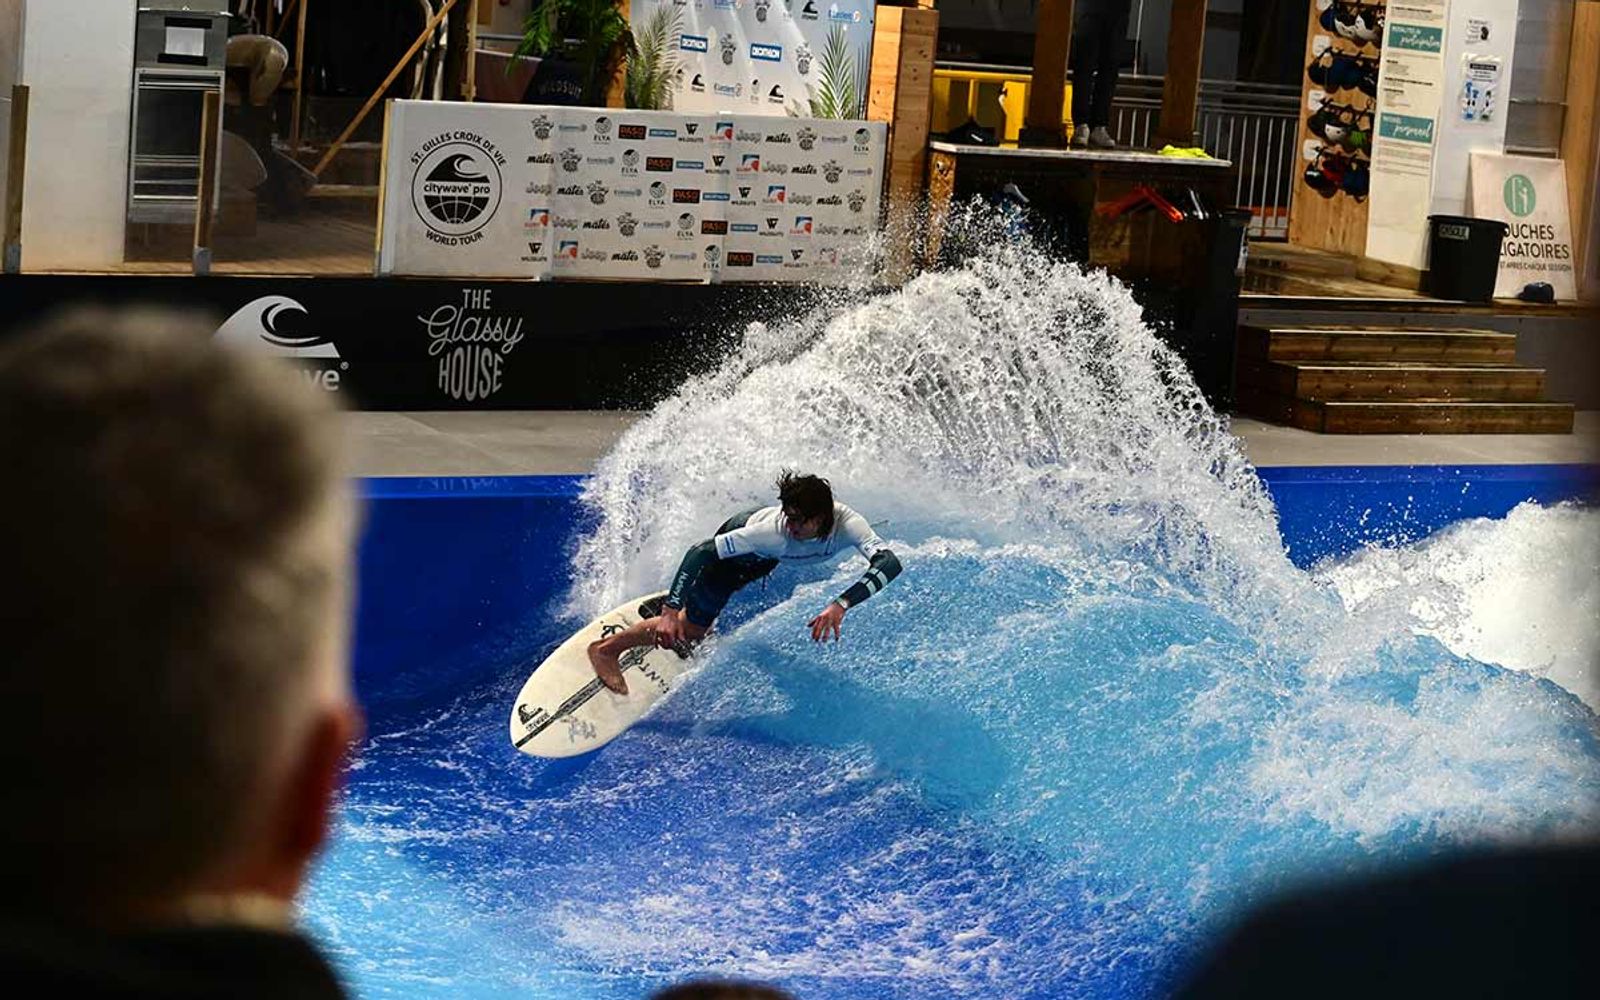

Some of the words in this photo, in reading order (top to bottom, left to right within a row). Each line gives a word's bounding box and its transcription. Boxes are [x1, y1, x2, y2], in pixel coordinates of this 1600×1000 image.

[411, 151, 424, 164] ST.
[423, 132, 452, 152] GILLES
[453, 131, 483, 144] CROIX
[482, 140, 495, 152] DE
[494, 150, 507, 166] VIE
[473, 186, 491, 195] pro
[426, 230, 458, 246] WORLD
[459, 231, 484, 245] TOUR
[1502, 223, 1555, 240] OUCHES
[462, 288, 492, 309] THE
[417, 304, 525, 356] Glassy
[438, 344, 504, 401] HOUSE
